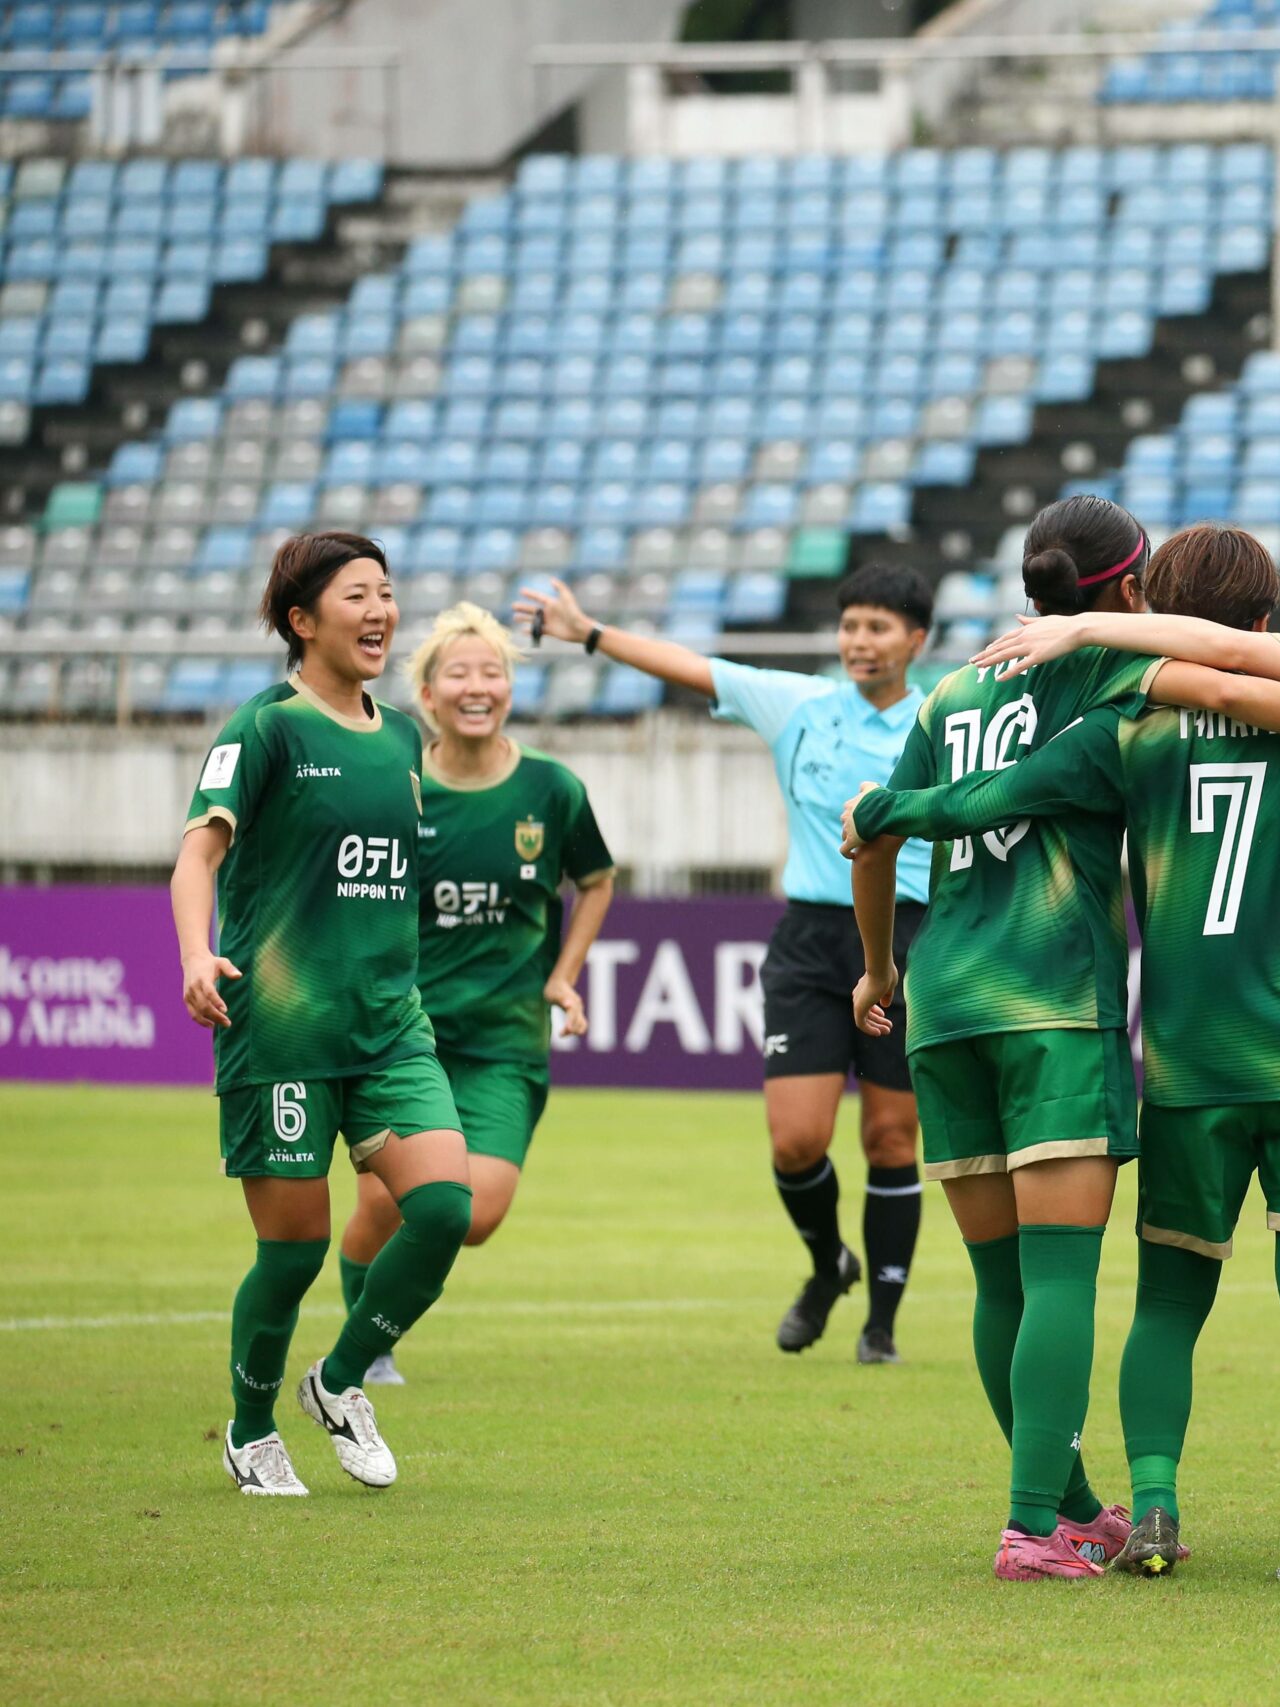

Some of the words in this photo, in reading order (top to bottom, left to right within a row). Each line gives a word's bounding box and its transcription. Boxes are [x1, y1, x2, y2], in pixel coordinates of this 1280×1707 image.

[295, 766, 342, 778] ATHLETA
[1190, 762, 1267, 935] 7
[337, 882, 387, 900] NIPPON
[390, 885, 407, 901] TV
[486, 909, 505, 925] TV
[550, 938, 767, 1053] TAR
[19, 993, 156, 1048] Arabia
[272, 1081, 307, 1142] 6
[268, 1151, 315, 1162] ATHLETA
